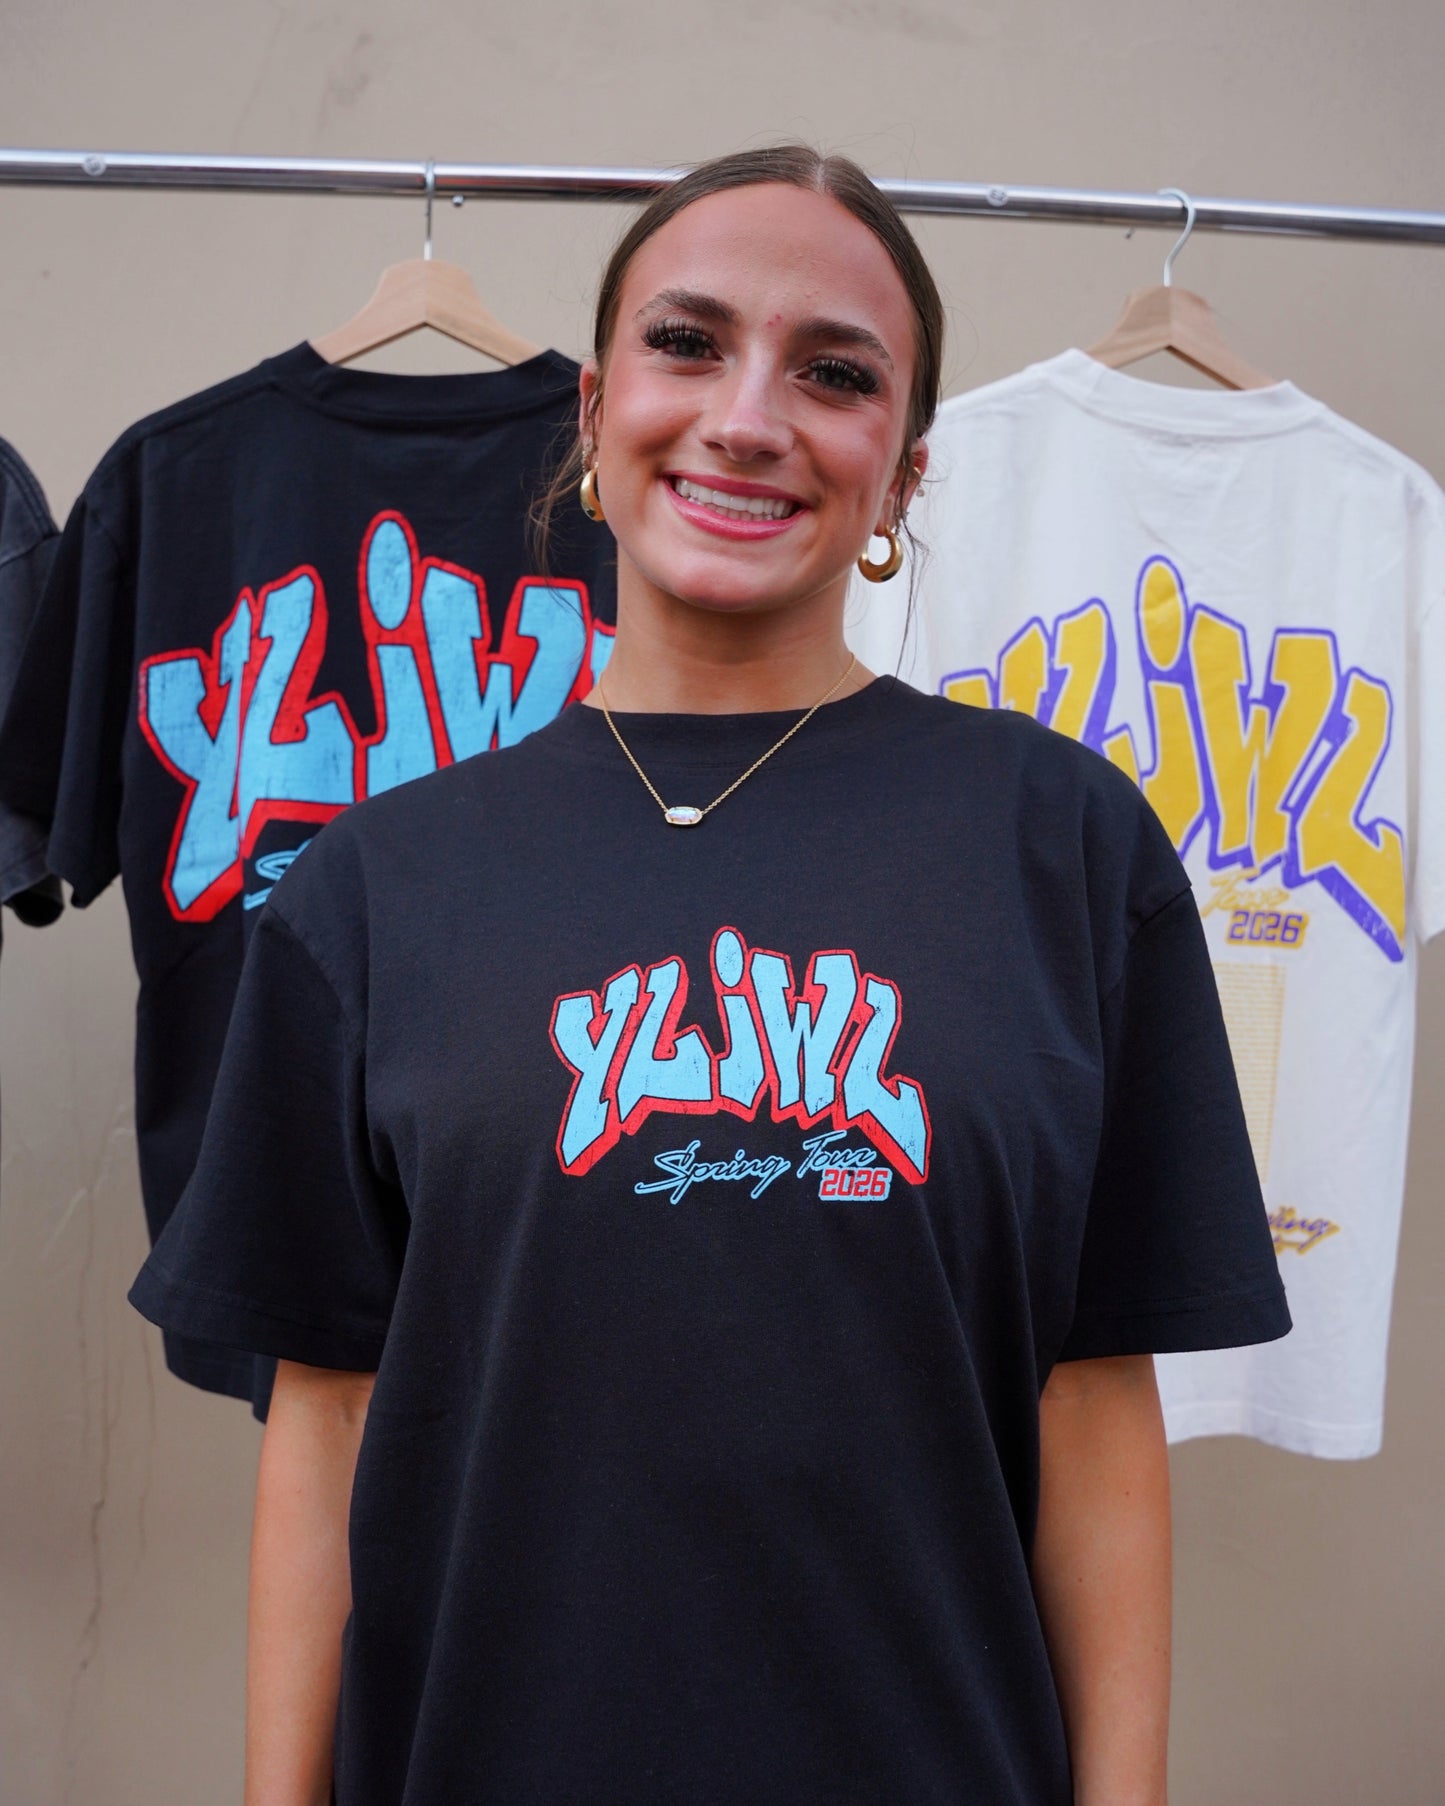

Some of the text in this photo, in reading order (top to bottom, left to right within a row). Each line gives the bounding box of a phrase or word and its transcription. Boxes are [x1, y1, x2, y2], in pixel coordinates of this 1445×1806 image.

[1227, 909, 1308, 947] 2026
[634, 1130, 877, 1205] Spring Tour
[819, 1167, 892, 1201] 2026
